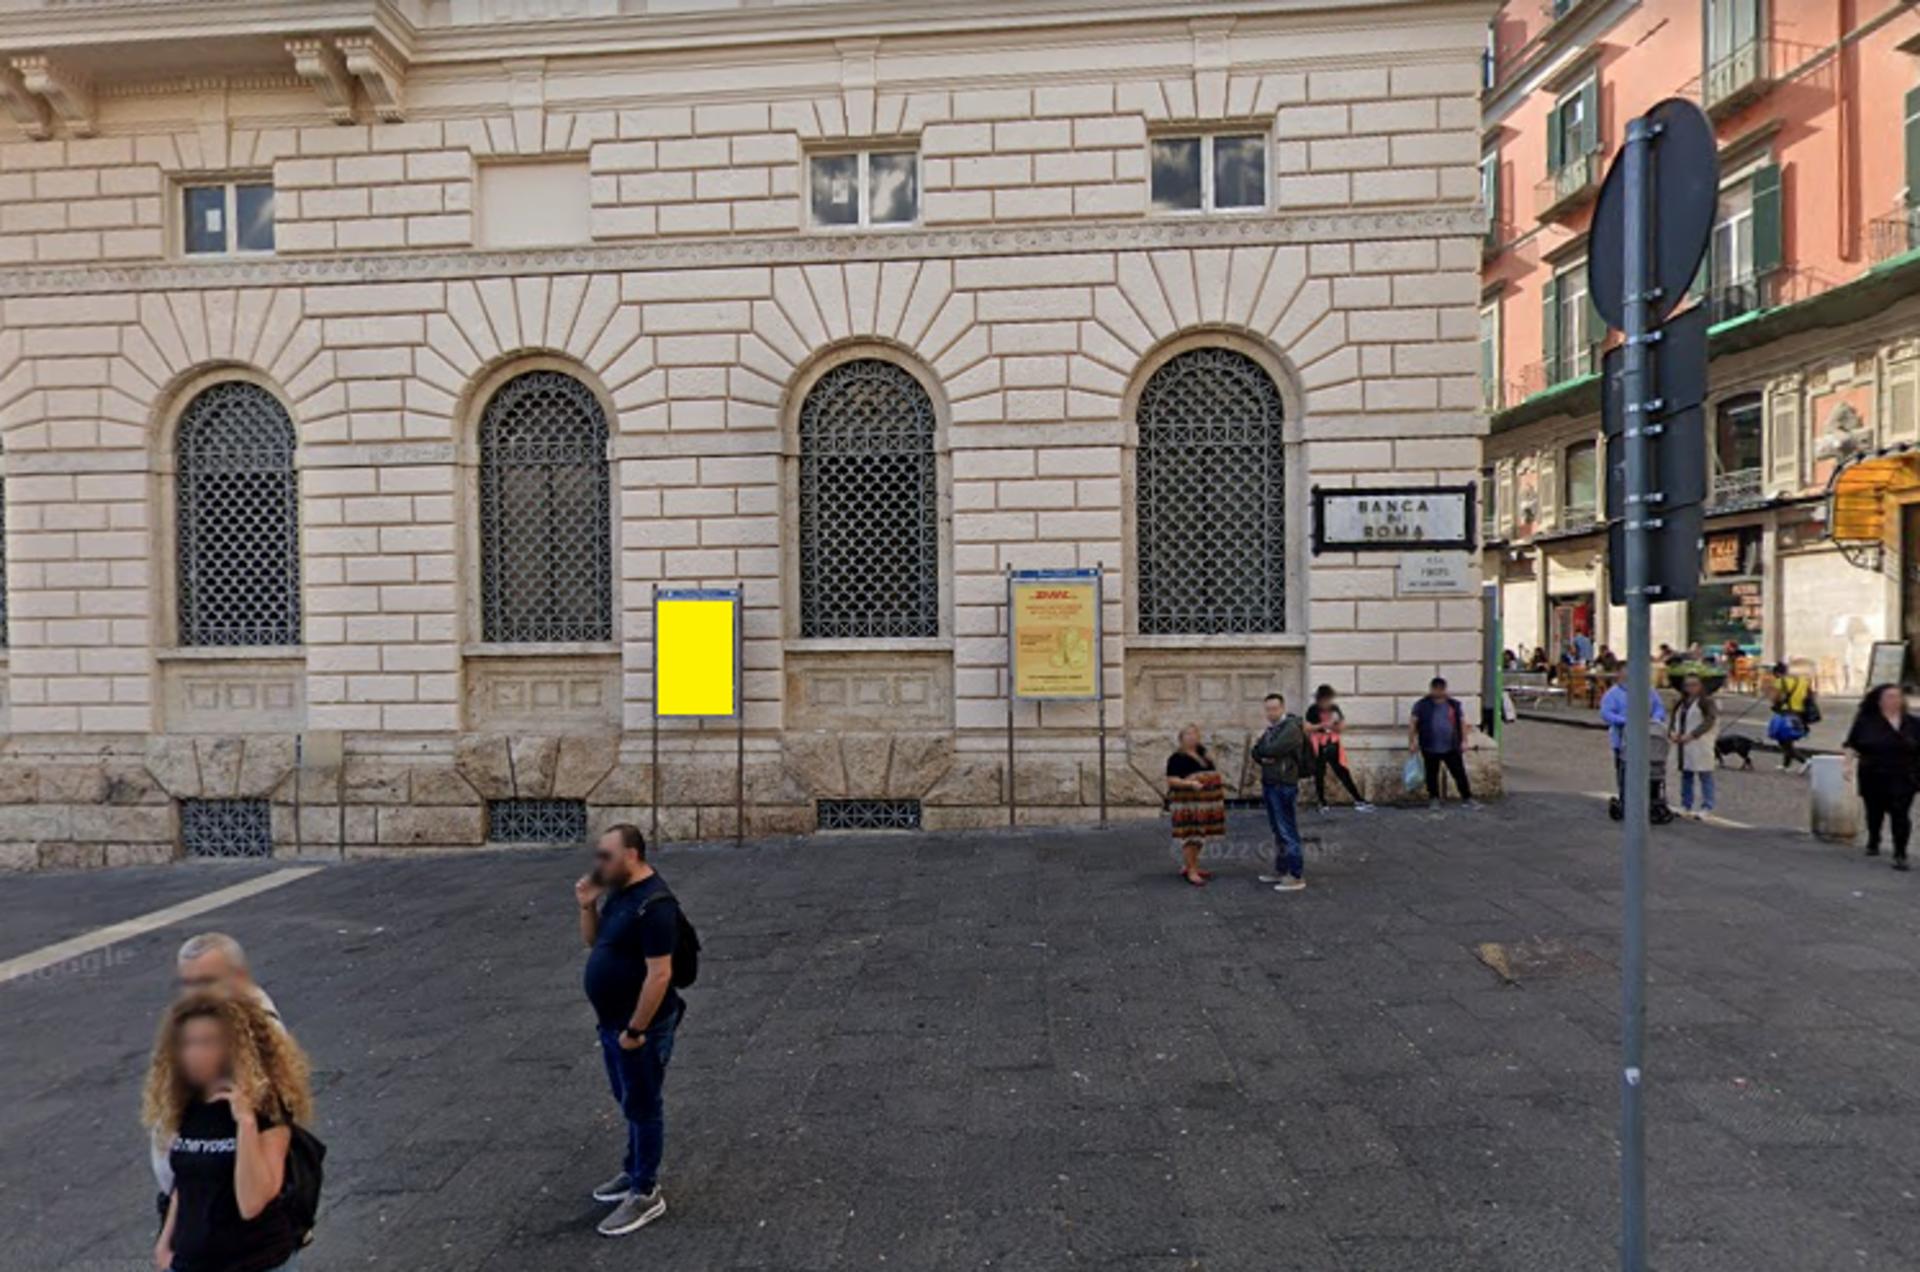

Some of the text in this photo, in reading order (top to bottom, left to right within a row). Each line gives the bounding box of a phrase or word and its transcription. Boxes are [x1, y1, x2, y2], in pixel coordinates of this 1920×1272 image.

[1358, 500, 1429, 513] BANCA
[1387, 514, 1402, 524] DI
[1364, 525, 1425, 538] ROMA
